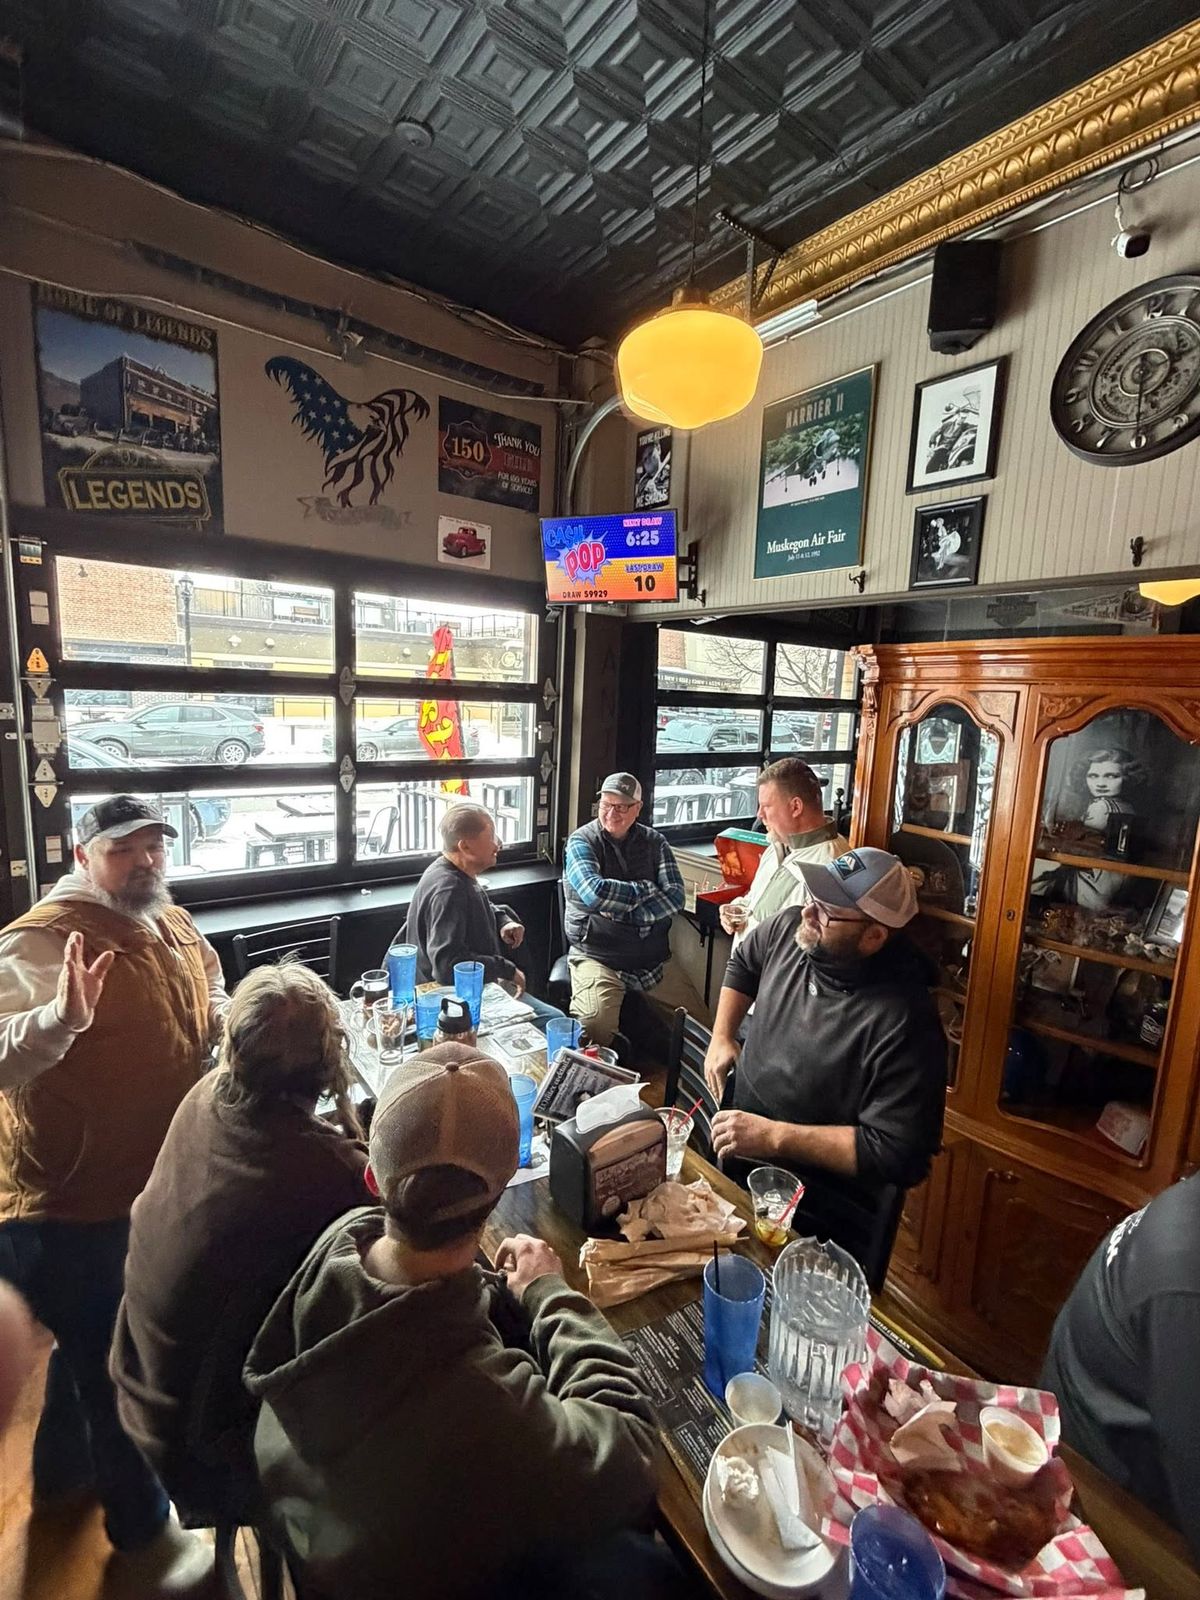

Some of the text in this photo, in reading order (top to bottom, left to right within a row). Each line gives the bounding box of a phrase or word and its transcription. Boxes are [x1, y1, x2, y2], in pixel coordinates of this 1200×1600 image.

[132, 309, 212, 351] LEGENDS
[786, 397, 831, 429] HARRIER
[836, 392, 844, 412] II
[452, 436, 484, 462] 150
[493, 432, 540, 457] THANK YOU
[70, 479, 202, 510] LEGENDS
[626, 530, 660, 547] 6:25
[766, 528, 846, 554] Muskegon Air Fair
[564, 542, 606, 581] POP
[642, 562, 664, 573] DRAW
[562, 590, 608, 599] DRAW 59929
[633, 574, 656, 592] 10
